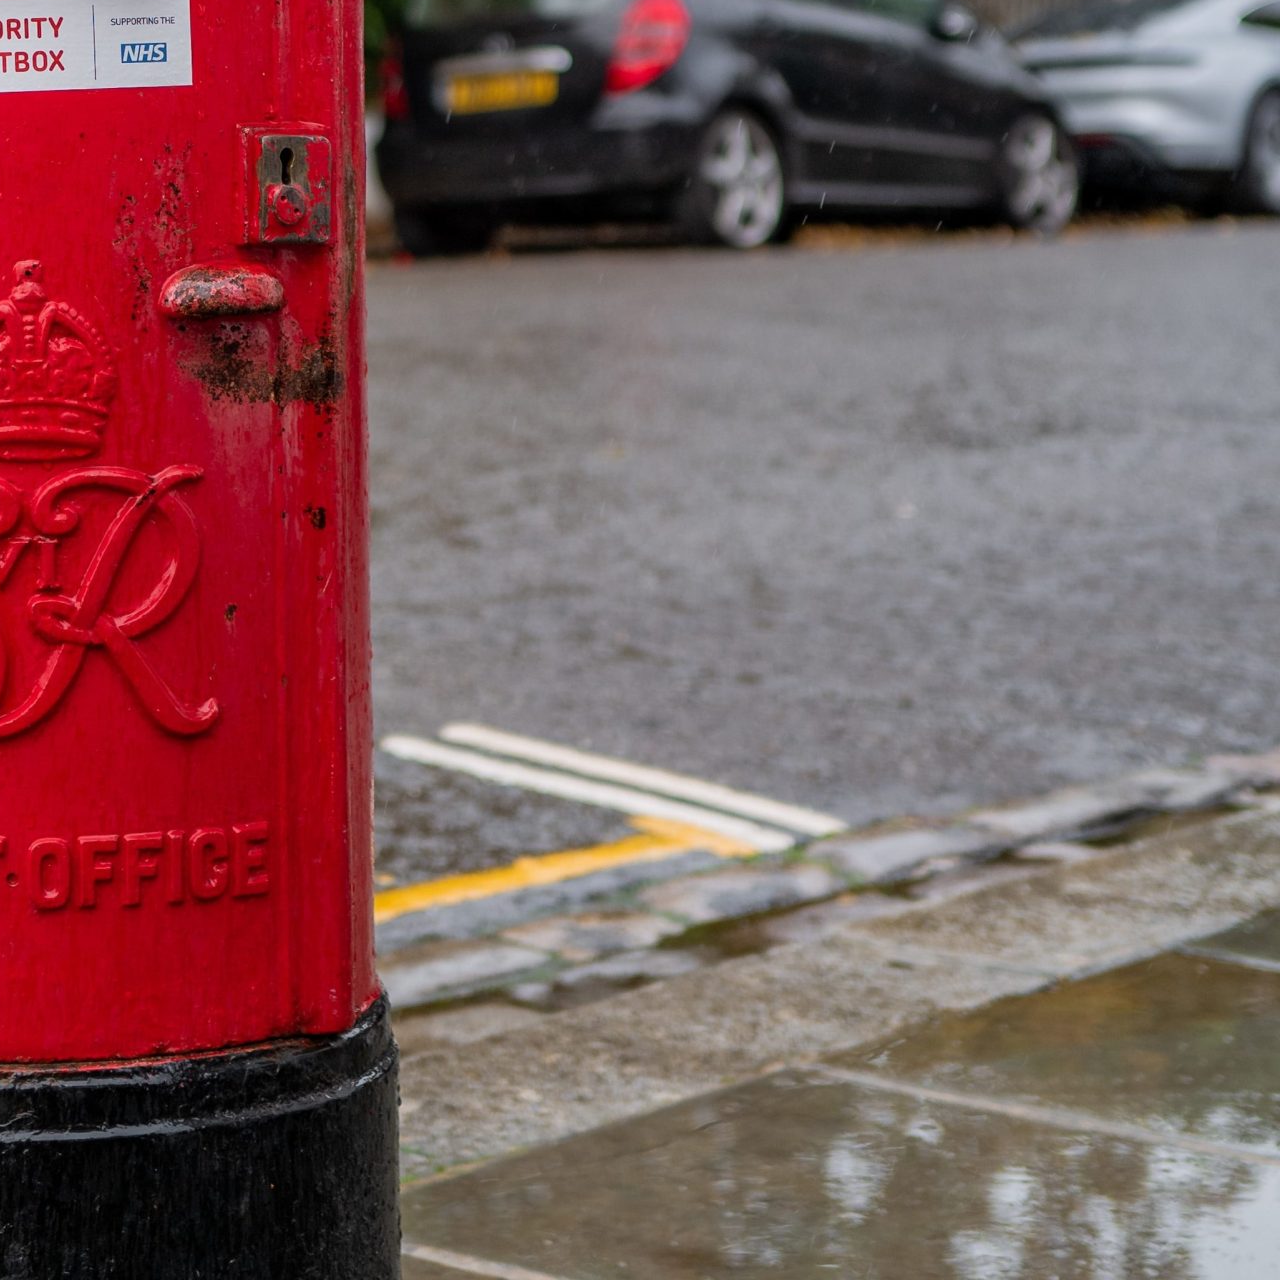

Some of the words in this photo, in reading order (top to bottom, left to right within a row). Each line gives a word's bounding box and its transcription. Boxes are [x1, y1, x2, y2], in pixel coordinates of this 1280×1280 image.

[110, 17, 159, 26] SUPPORTING
[160, 16, 176, 25] THE
[122, 44, 166, 62] NHS
[27, 820, 270, 911] OFFICE
